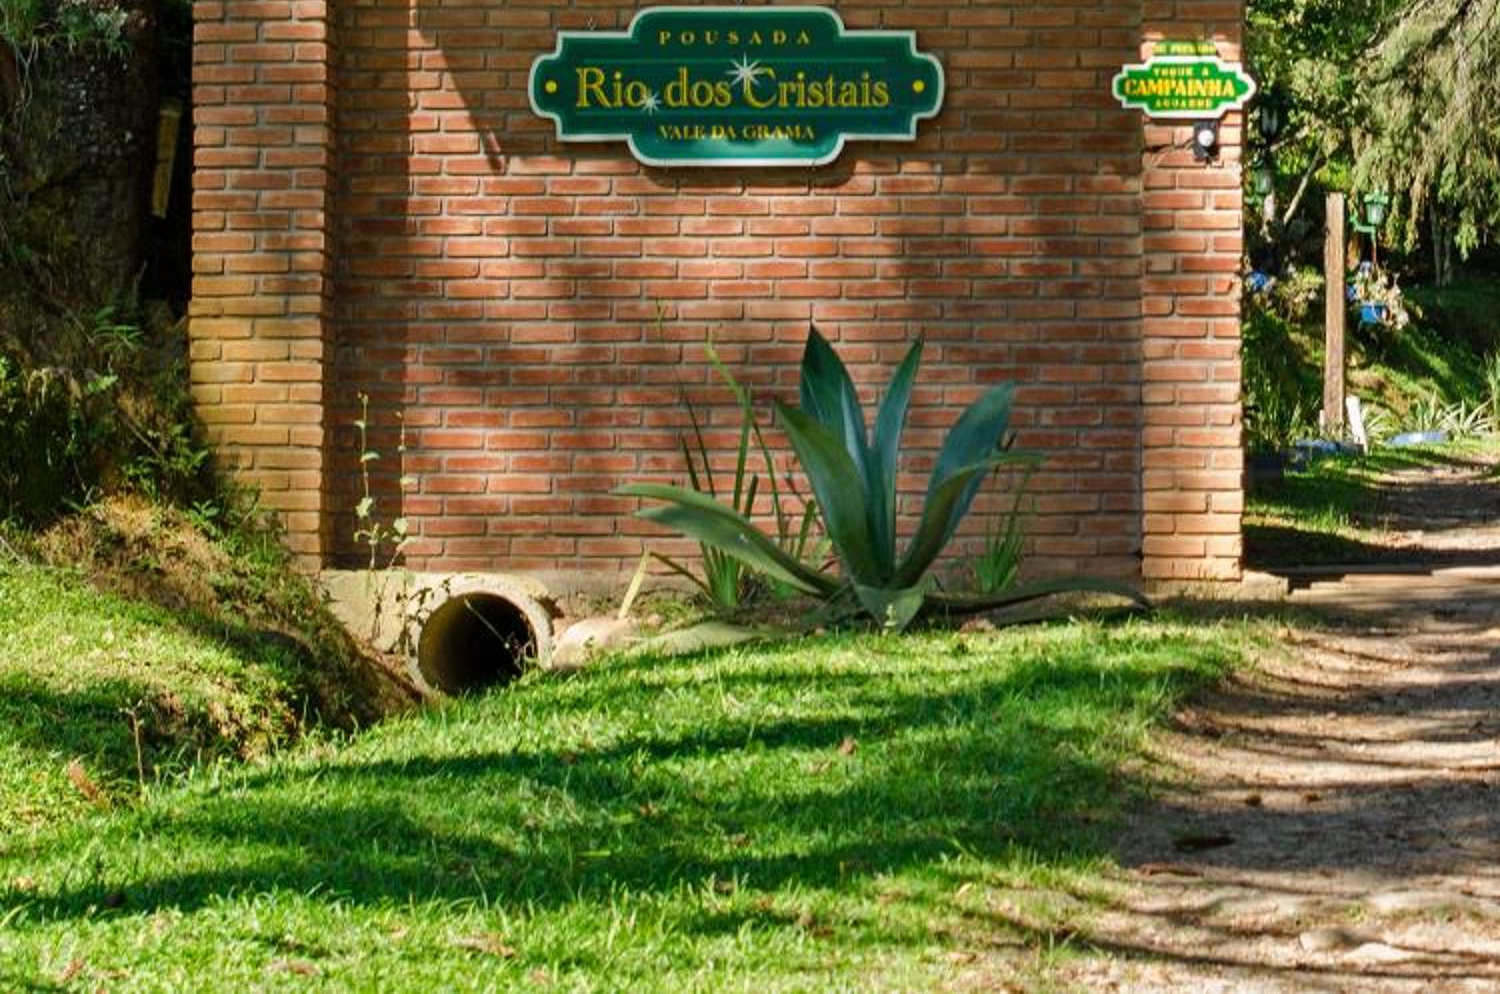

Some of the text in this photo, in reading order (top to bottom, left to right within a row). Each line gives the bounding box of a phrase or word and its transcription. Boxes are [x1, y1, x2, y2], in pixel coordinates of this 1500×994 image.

[659, 30, 811, 46] POUSADA
[575, 67, 889, 108] Rio dos Cristais
[1124, 78, 1235, 97] CAMPAINHA
[658, 125, 815, 141] VALE DA GRAMA
